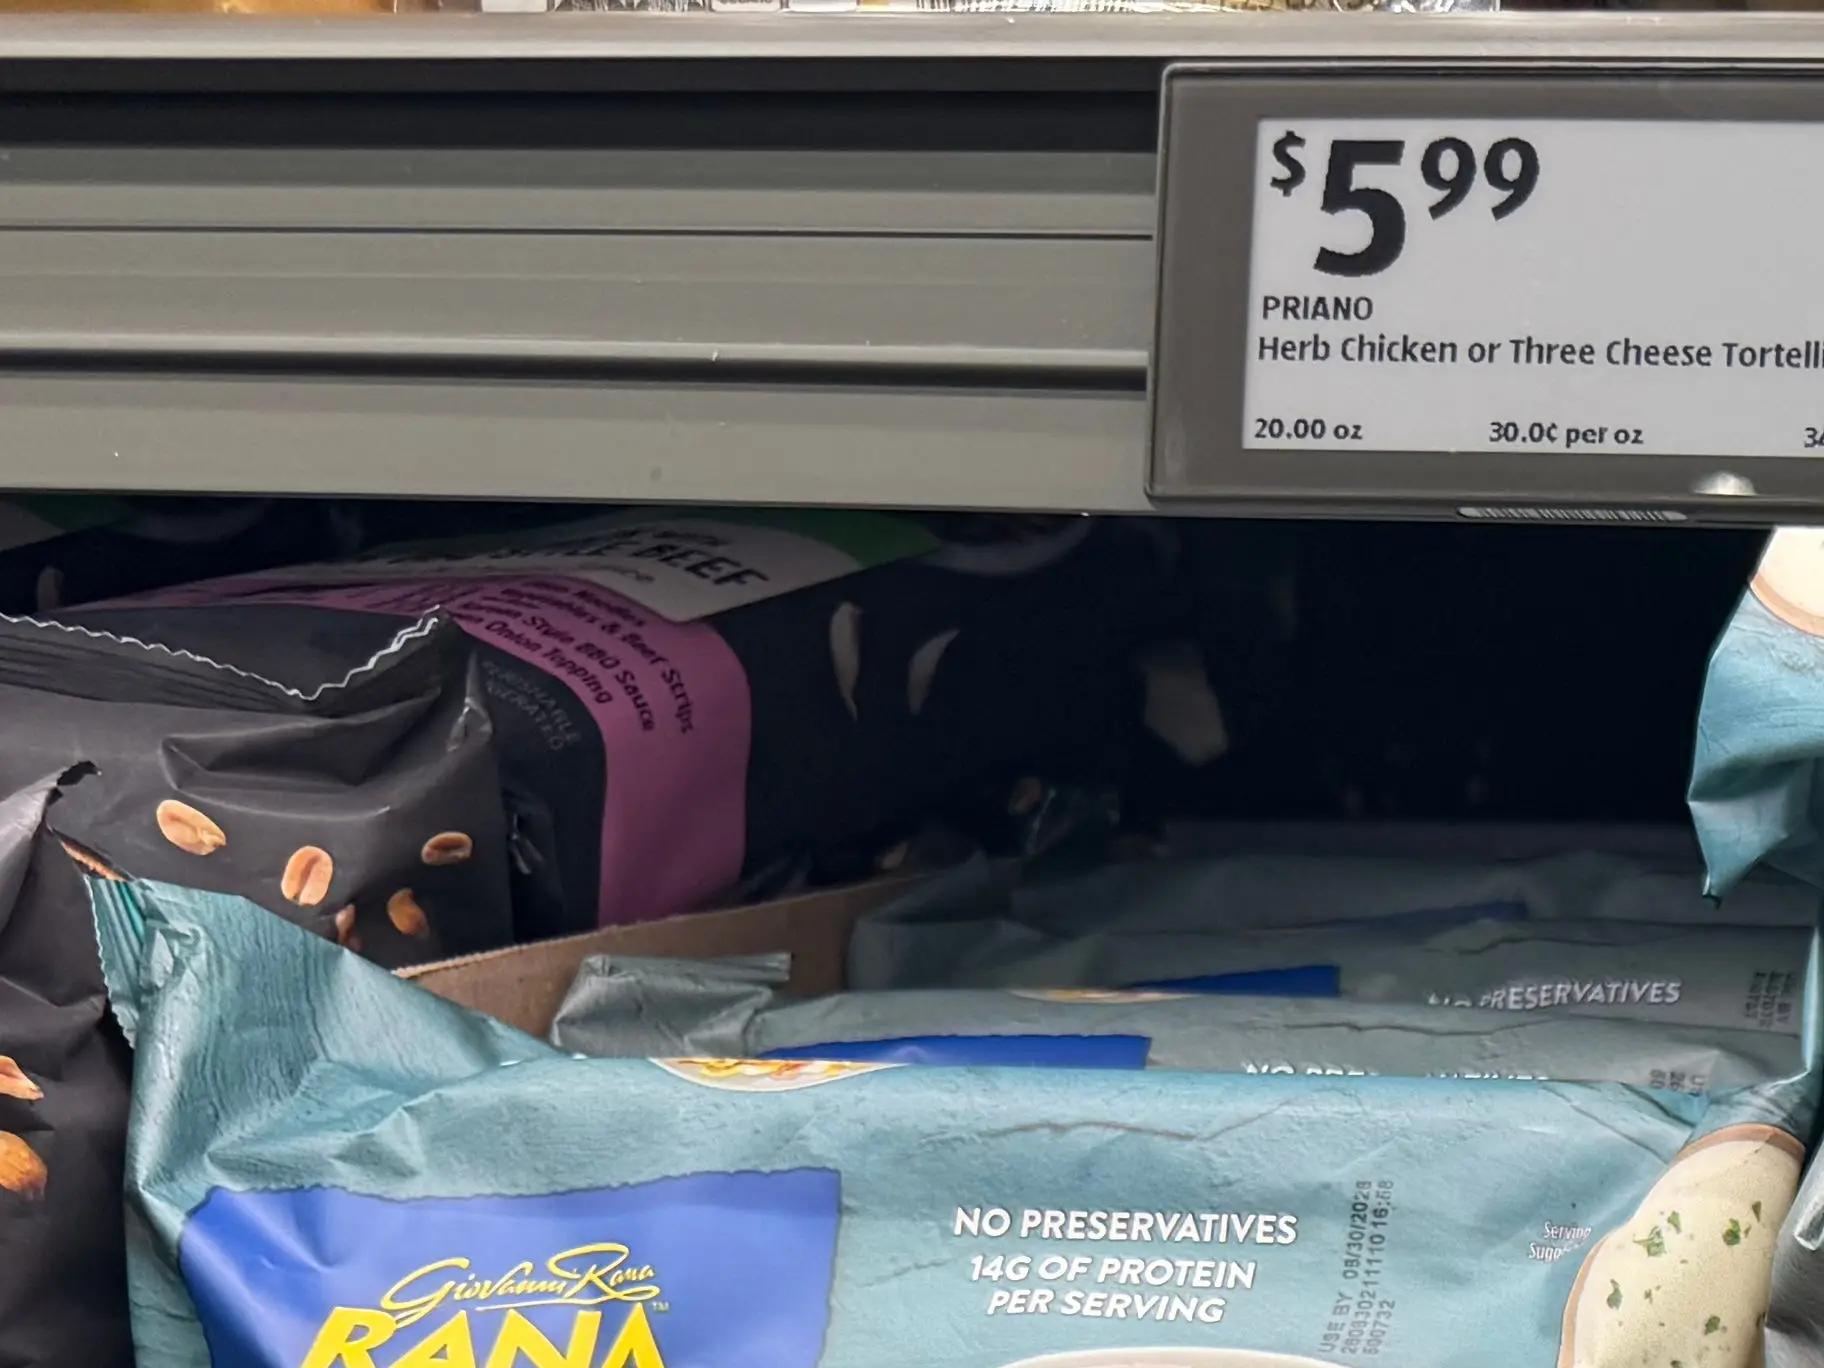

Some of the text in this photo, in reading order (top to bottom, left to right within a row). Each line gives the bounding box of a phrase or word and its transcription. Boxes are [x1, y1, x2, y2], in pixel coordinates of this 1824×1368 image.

[1262, 296, 1373, 321] PRIANO
[1257, 335, 1330, 363] Herb
[1340, 335, 1457, 365] Chicken
[1467, 343, 1501, 365] or
[1509, 336, 1595, 366] Three
[1606, 338, 1713, 367] Cheese
[1254, 418, 1363, 442] 20.00 oz
[1565, 425, 1606, 448] per
[1613, 427, 1644, 445] oz
[542, 648, 613, 705] Topping
[615, 668, 655, 732] Sauce
[660, 668, 695, 735] Strips
[954, 1208, 1298, 1246] NO PRESERVATIVES
[970, 1256, 1255, 1290] 14G OF PROTEIN
[987, 1289, 1225, 1324] PER SERVING
